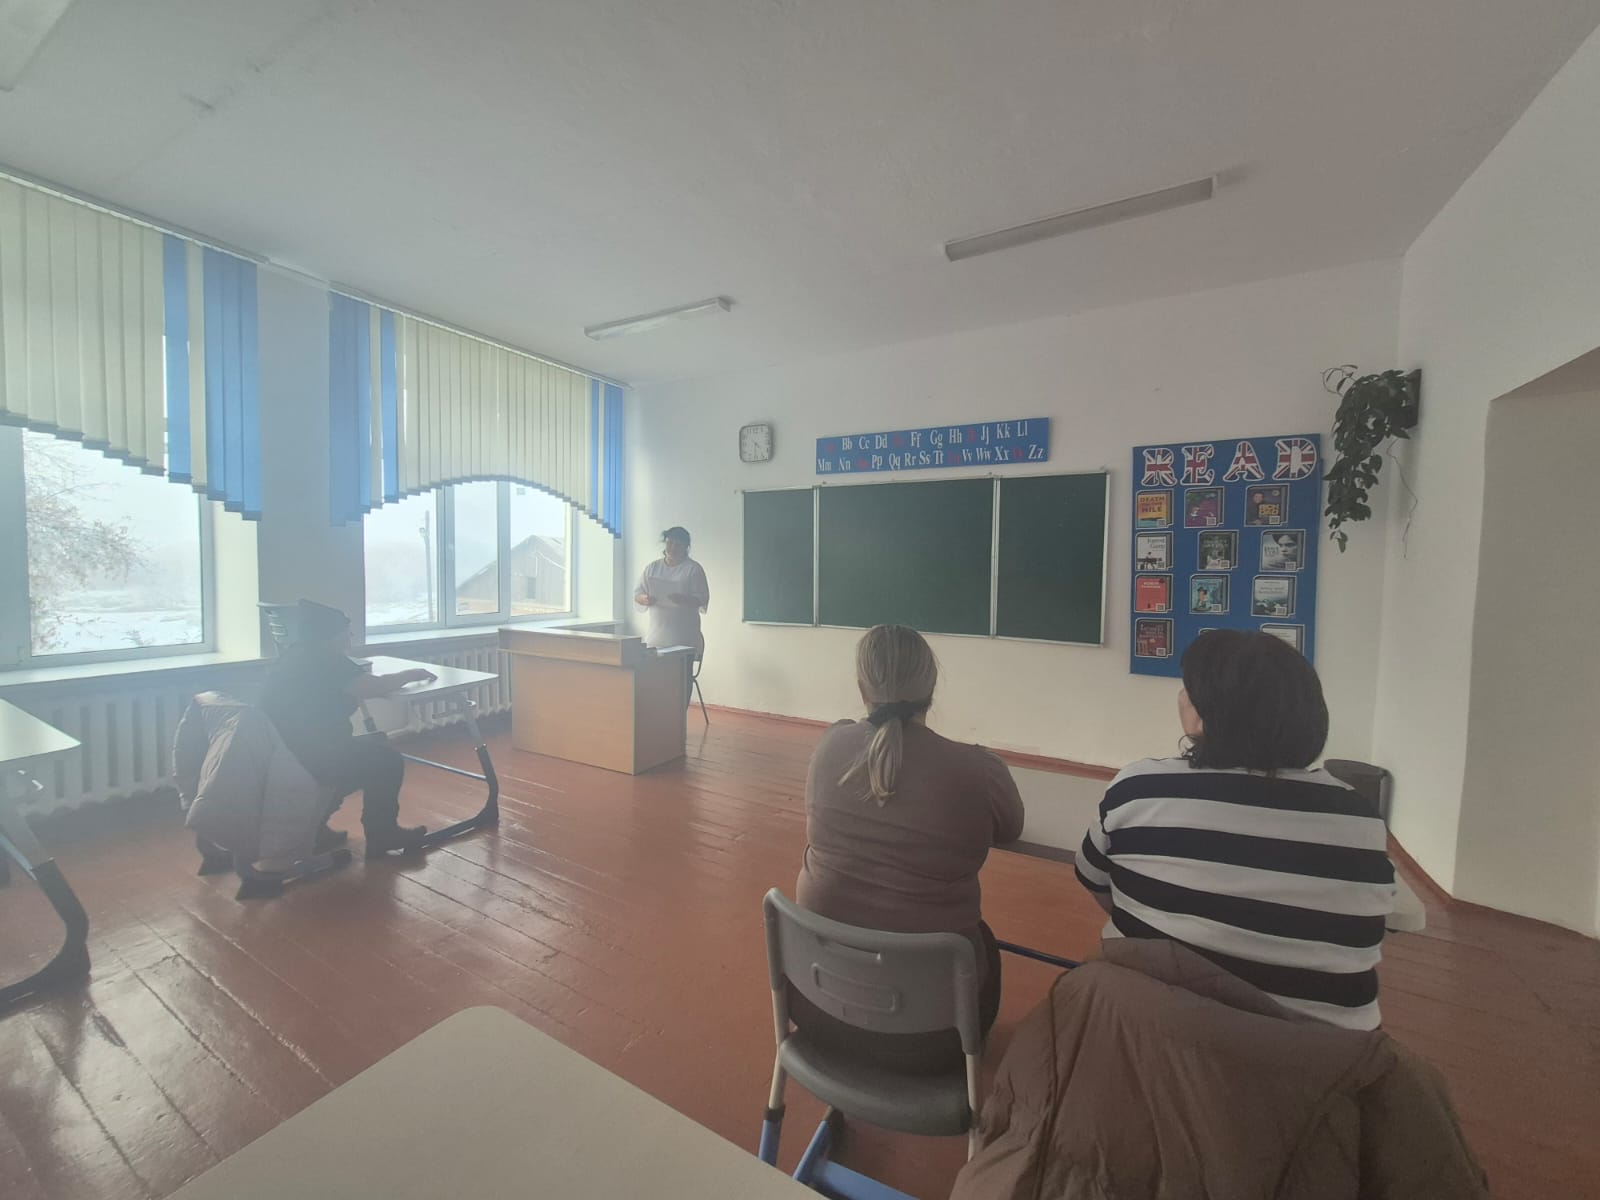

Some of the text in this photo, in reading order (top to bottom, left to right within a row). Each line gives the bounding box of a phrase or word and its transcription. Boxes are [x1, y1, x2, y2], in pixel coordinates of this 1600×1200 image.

[842, 437, 853, 451] Bb
[858, 436, 870, 450] Cc
[875, 434, 887, 449] Dd
[910, 431, 922, 448] Ff
[930, 429, 943, 449] Gg
[949, 428, 962, 444] Hh
[980, 425, 989, 445] Jj
[996, 423, 1011, 439] Kk
[1017, 421, 1028, 437] Ll
[817, 458, 832, 472] Mm
[838, 457, 851, 472] Nn
[871, 454, 883, 470] Pp
[889, 453, 900, 471] Qq
[904, 452, 916, 466] Rr
[919, 450, 930, 465] Ss
[933, 450, 944, 465] Tt
[962, 448, 972, 462] Vv
[976, 447, 992, 462] Ww
[995, 445, 1010, 461] Xx
[1028, 444, 1044, 459] Zz
[1141, 438, 1317, 487] READ
